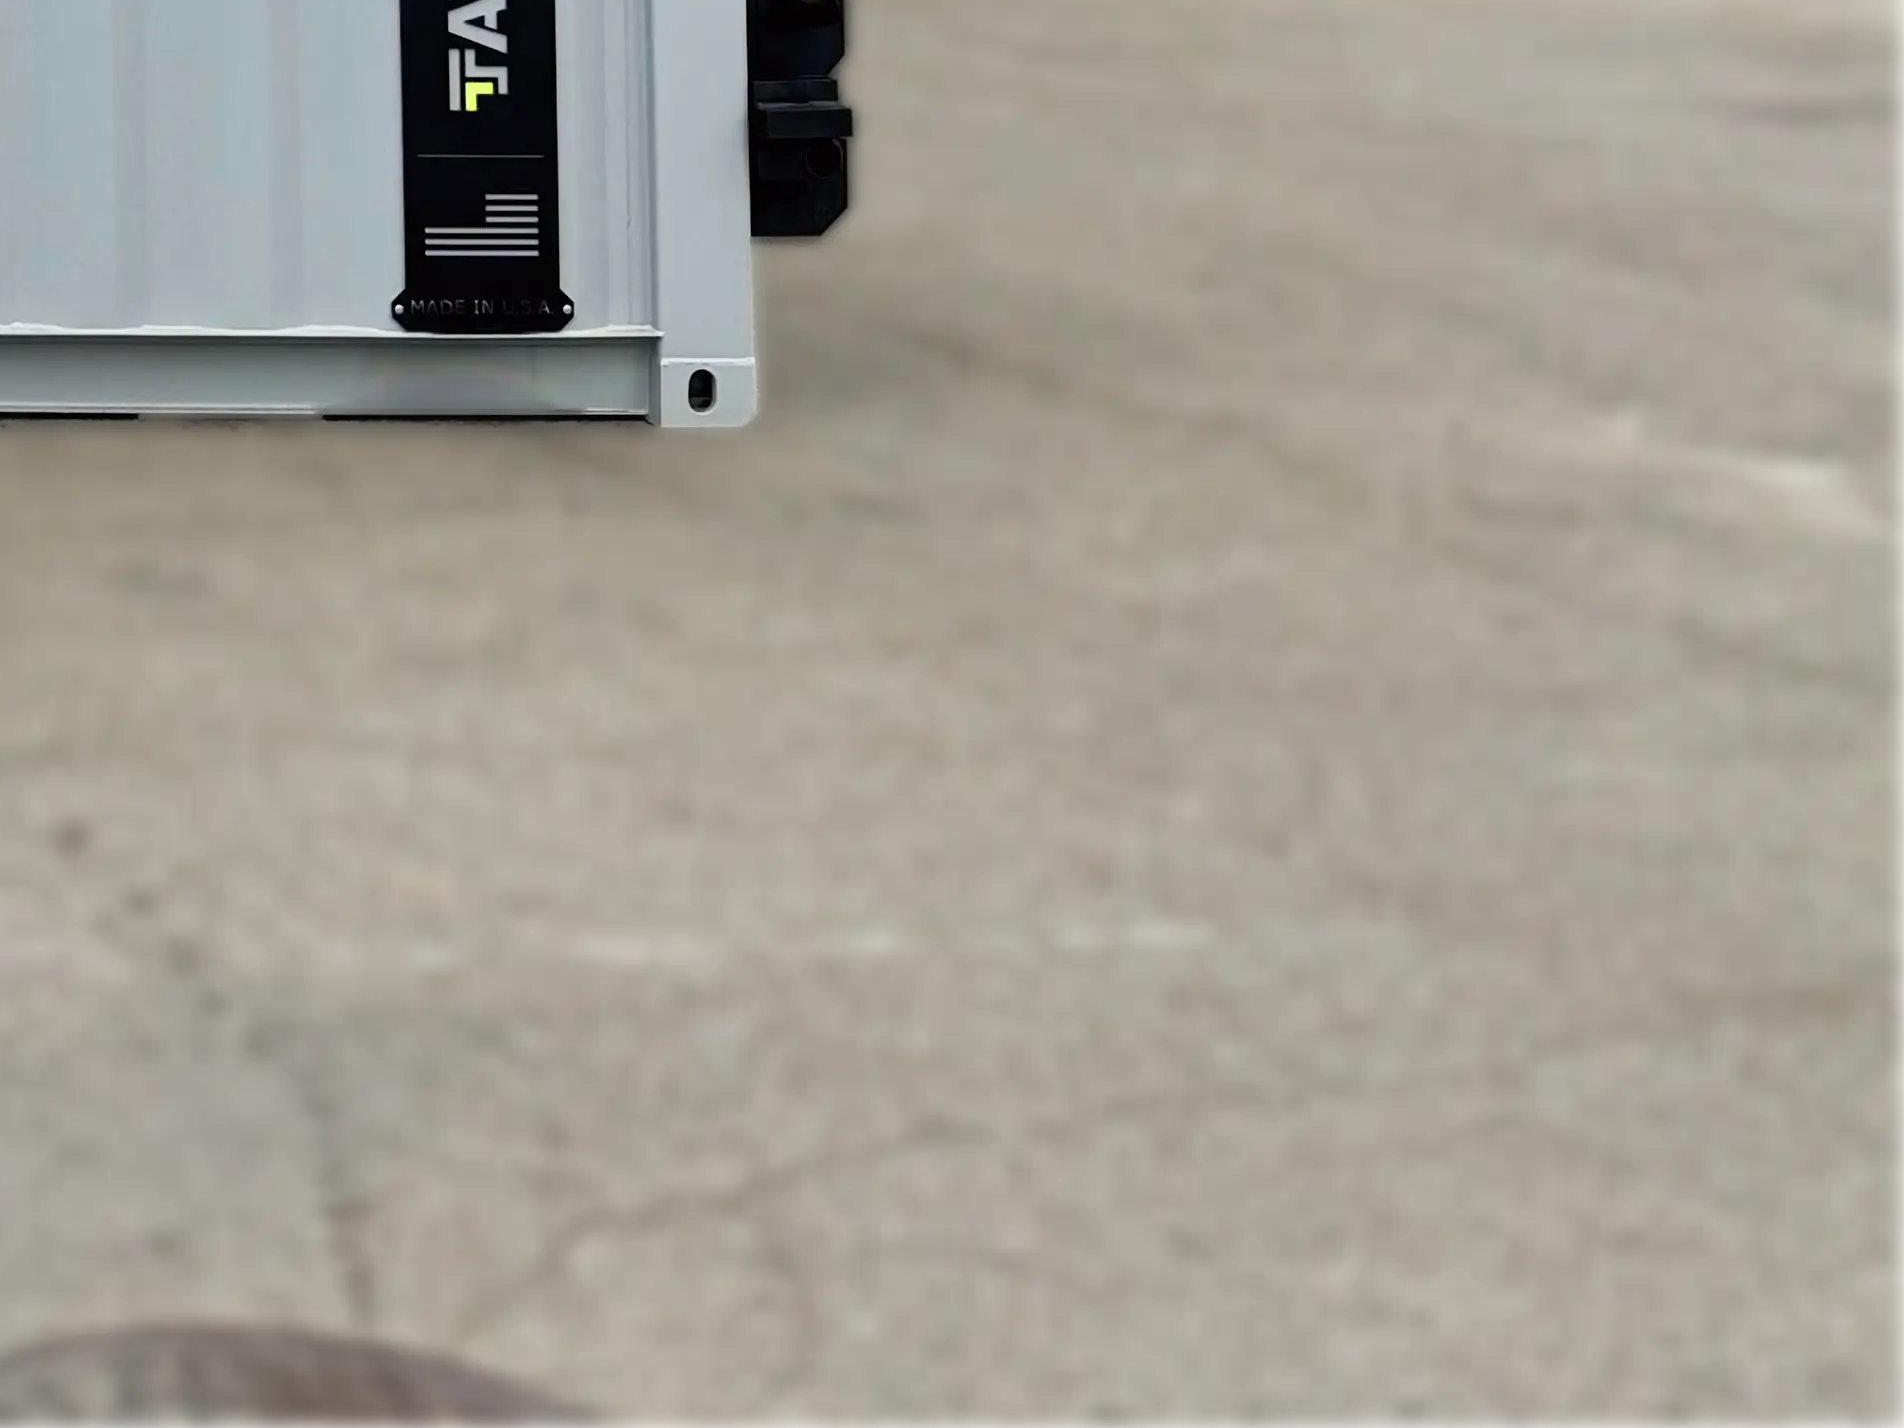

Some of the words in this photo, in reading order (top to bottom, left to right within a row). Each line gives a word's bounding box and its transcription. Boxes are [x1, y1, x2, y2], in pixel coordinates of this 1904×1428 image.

[410, 299, 465, 315] MADE
[474, 299, 495, 315] IN
[502, 299, 555, 315] U.S.A.
